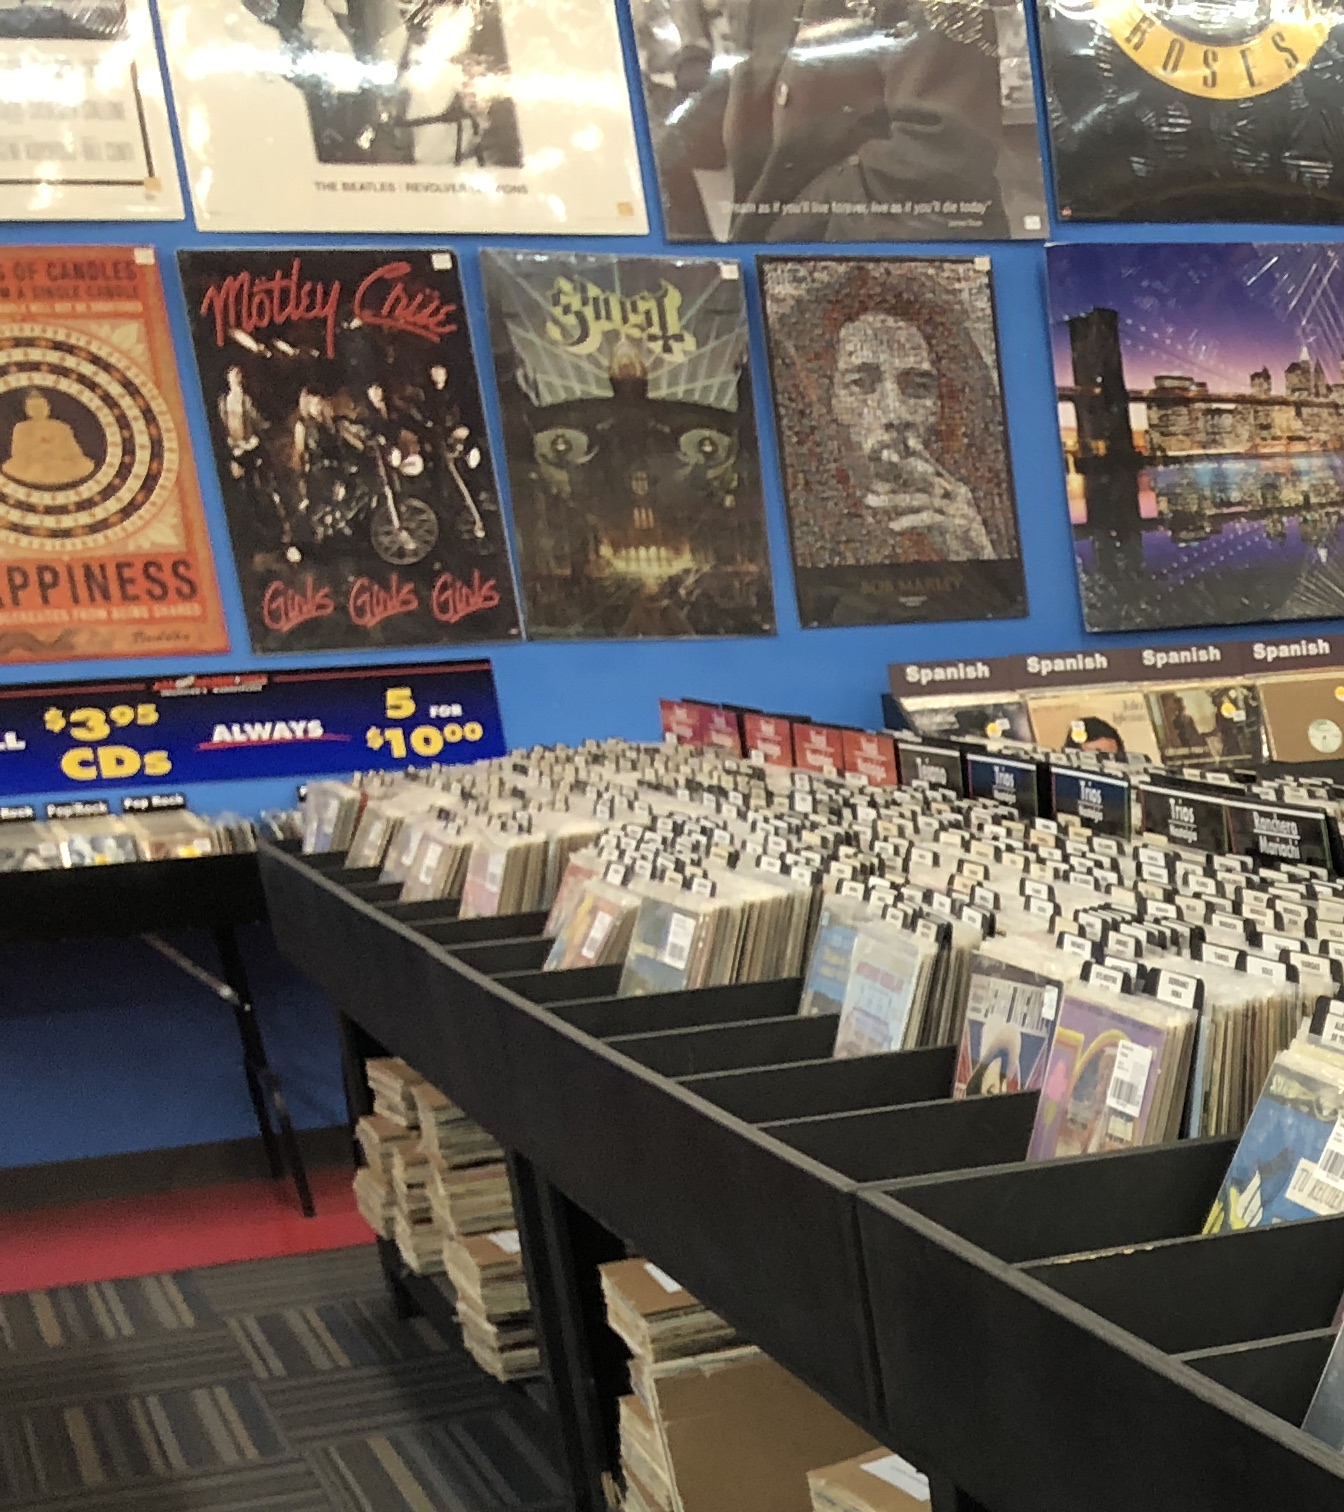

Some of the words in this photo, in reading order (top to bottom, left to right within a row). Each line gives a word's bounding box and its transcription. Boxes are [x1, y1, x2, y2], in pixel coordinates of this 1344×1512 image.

[1253, 639, 1330, 660] Spanish
[385, 687, 416, 720] 5
[430, 703, 462, 717] FOR
[212, 720, 324, 744] ALWAYS
[60, 745, 172, 780] CDs
